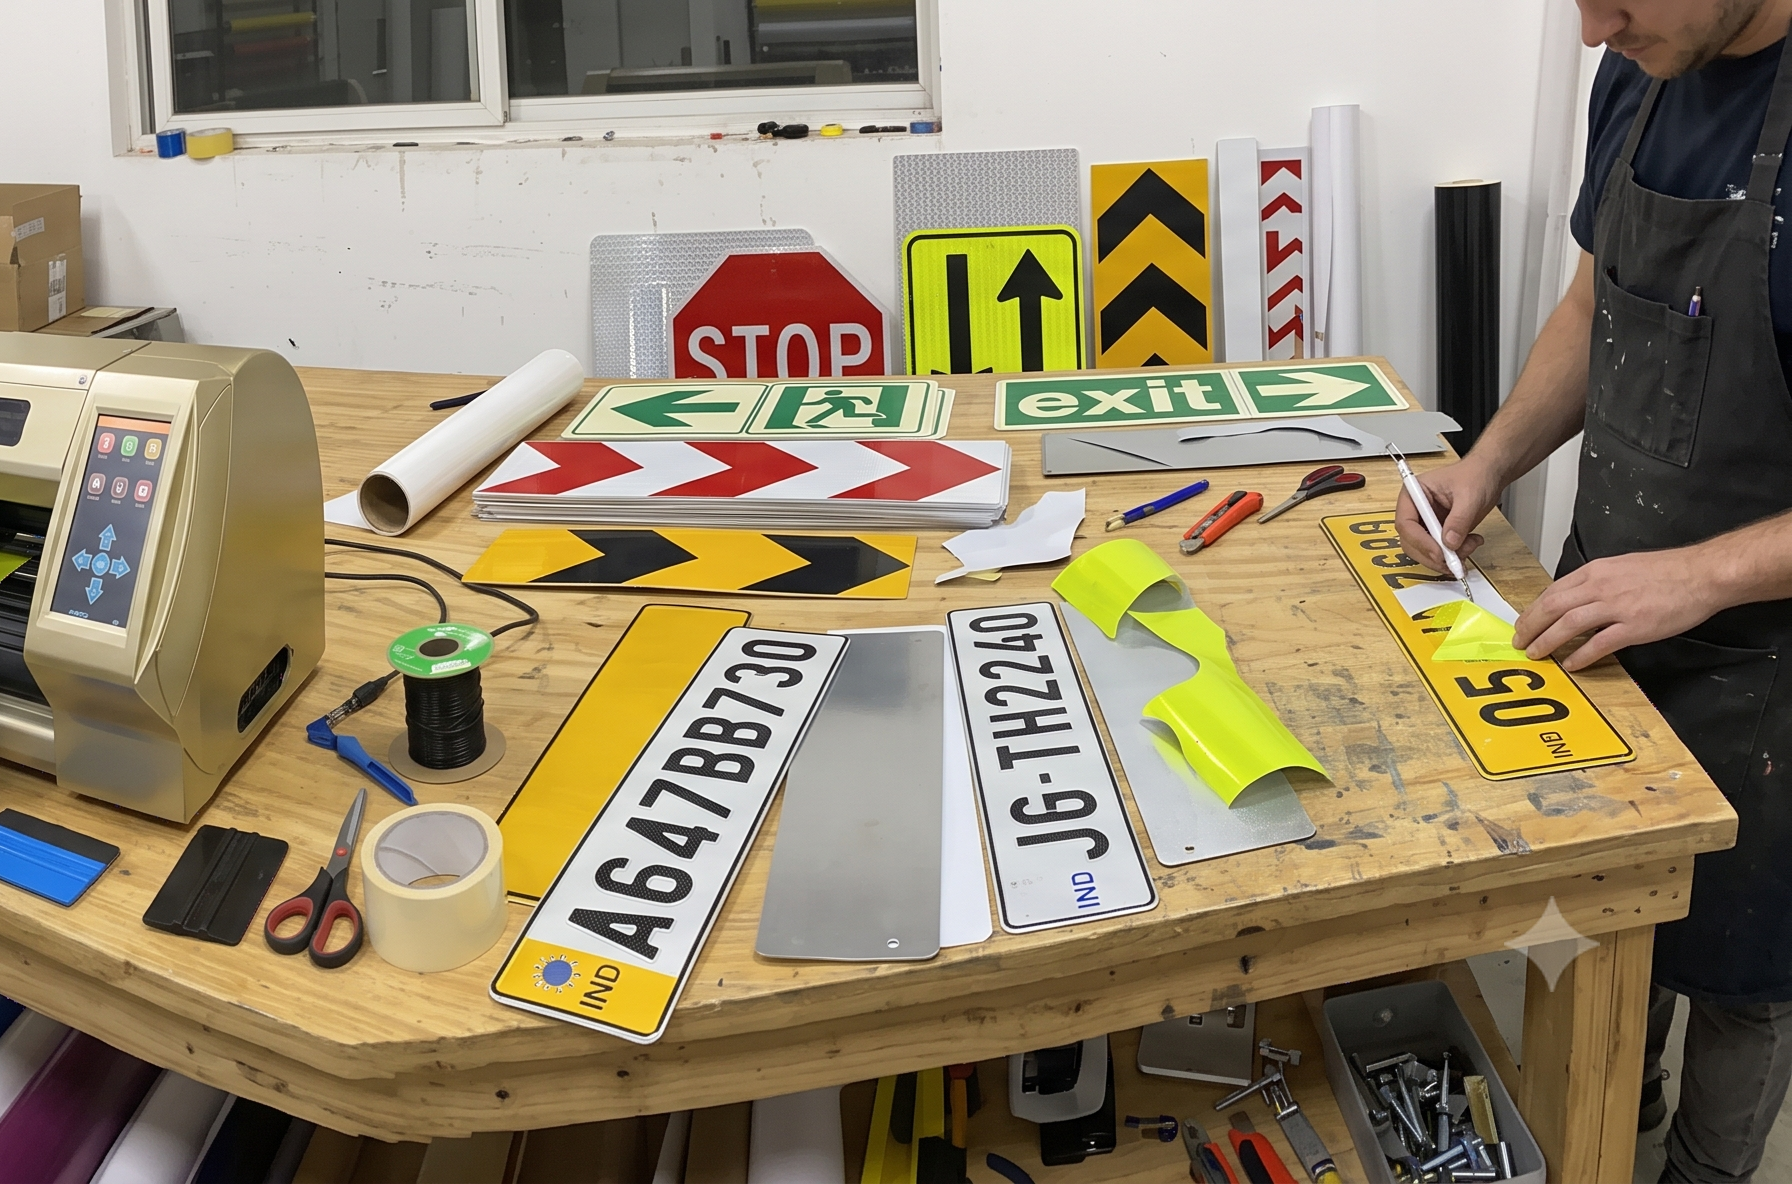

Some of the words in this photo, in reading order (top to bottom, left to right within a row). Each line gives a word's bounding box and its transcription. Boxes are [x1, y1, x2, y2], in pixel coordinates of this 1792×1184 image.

[687, 322, 873, 379] STOP
[1017, 379, 1223, 419] exit
[567, 638, 817, 961] A647BB730
[1071, 871, 1101, 909] IND
[579, 964, 621, 1011] IND
